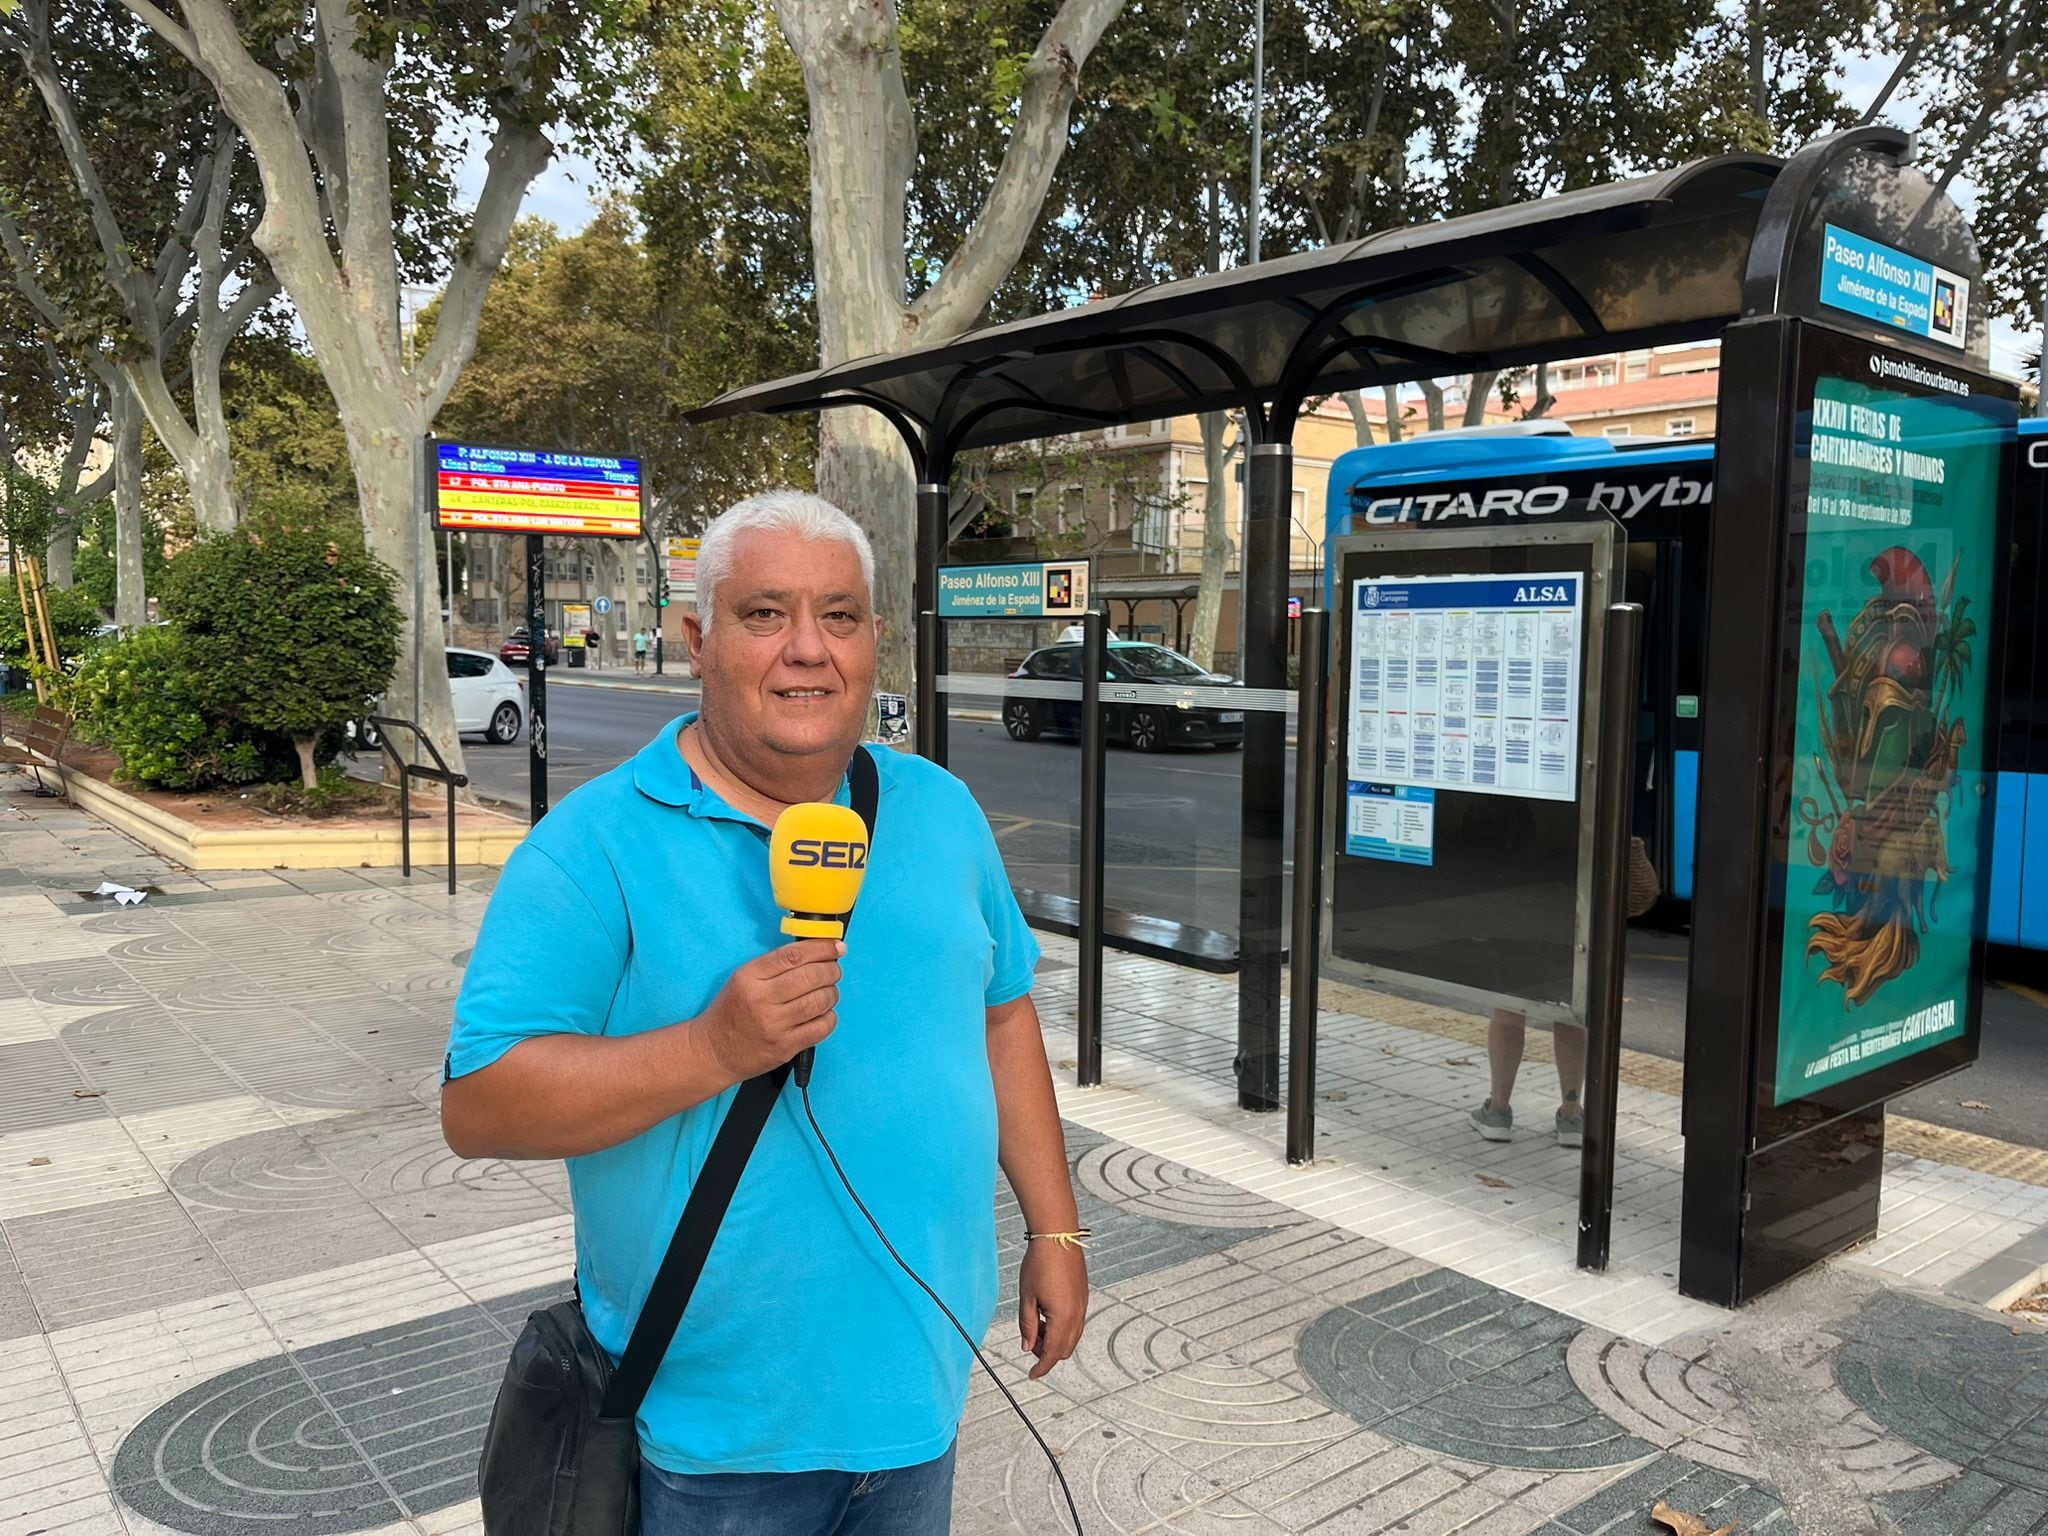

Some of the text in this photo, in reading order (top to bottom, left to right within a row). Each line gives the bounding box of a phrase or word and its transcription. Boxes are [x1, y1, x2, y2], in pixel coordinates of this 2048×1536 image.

[1826, 235, 1931, 296] Paseo Alfonso XIII
[1837, 274, 1875, 301] Jiménez
[1875, 287, 1888, 307] de
[1889, 291, 1897, 311] la
[1898, 295, 1928, 320] Espada
[1880, 354, 1970, 397] jsmobiliariourbano.es
[1812, 398, 1902, 443] XXXVI FIESTAS DE
[469, 448, 517, 462] ALFONSO
[518, 451, 537, 463] XIII
[554, 454, 568, 466] DE
[568, 455, 582, 467] LA
[583, 456, 621, 470] ESPADA
[1810, 433, 1945, 485] CARTHAGINESES Y ROMANOS
[469, 460, 506, 473] Destino
[602, 470, 635, 484] Tiempo
[1365, 485, 1569, 524] CITARO
[1807, 495, 1820, 514] Del
[1830, 498, 1837, 516] al
[1839, 498, 1851, 517] 28
[940, 571, 1040, 590] Paseo Alfonso XIII
[951, 593, 1040, 608] Jiménez de la Espada
[1380, 595, 1408, 603] Cartagena
[1513, 585, 1568, 603] ALSA
[1902, 999, 1955, 1043] CARTAGENA
[1829, 1047, 1849, 1070] FIESTA
